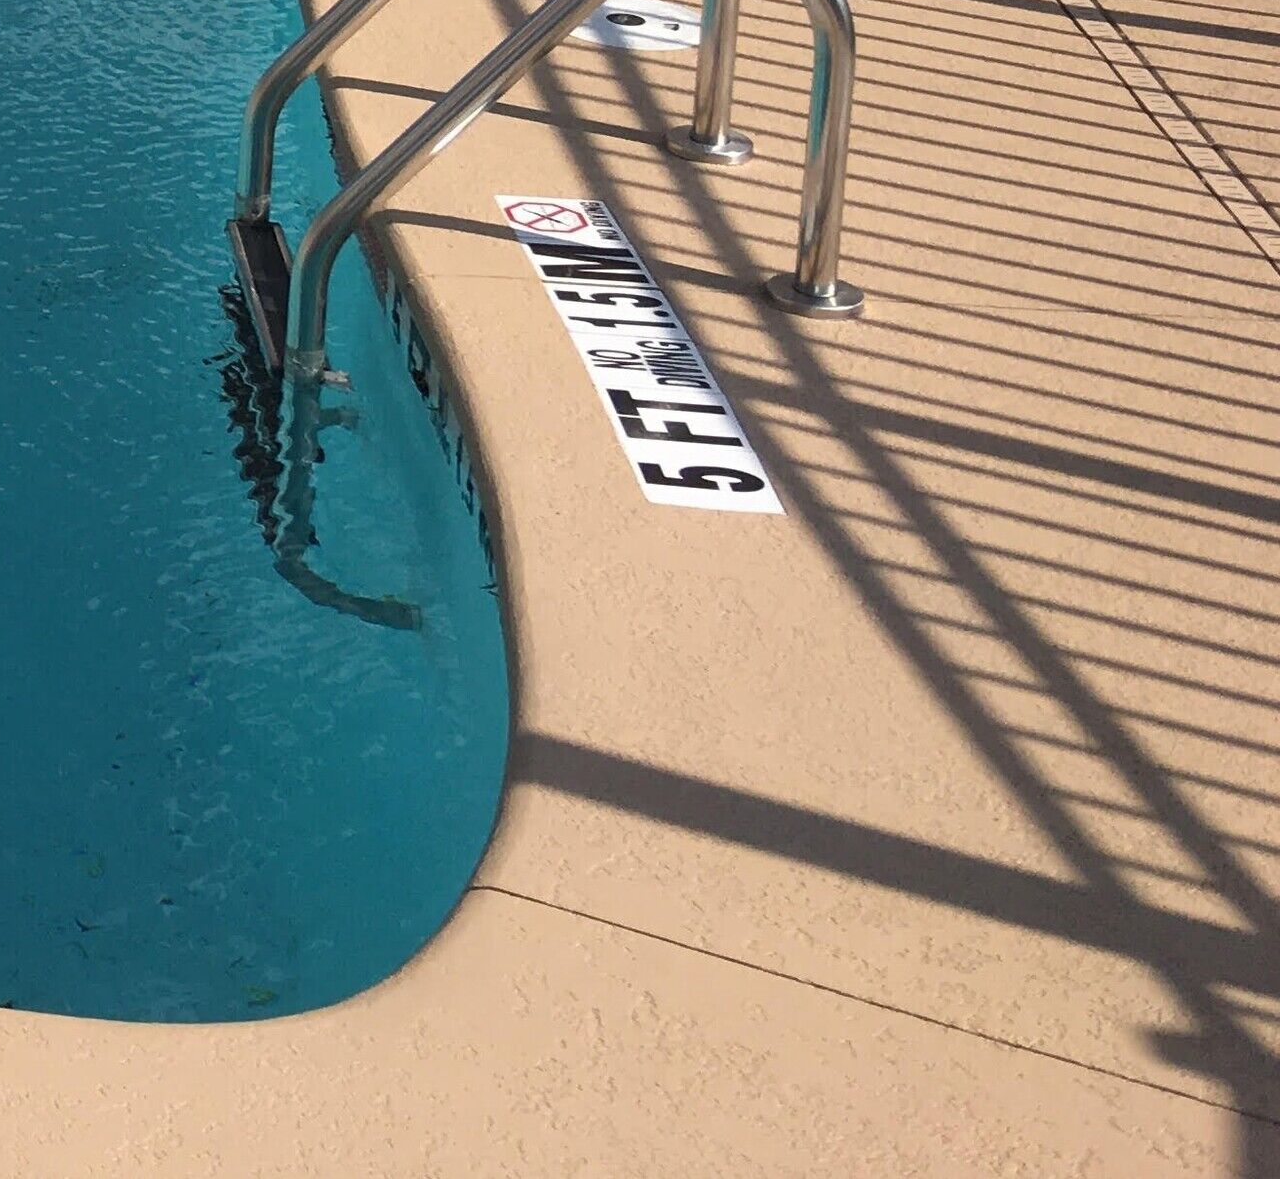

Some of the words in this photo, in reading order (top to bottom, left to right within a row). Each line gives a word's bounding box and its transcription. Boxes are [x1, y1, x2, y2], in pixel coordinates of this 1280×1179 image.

[528, 242, 650, 284] M
[554, 290, 677, 329] 1.5
[587, 349, 646, 372] NO
[636, 340, 711, 389] DIVING
[606, 388, 744, 448] FT
[637, 461, 765, 493] 5
